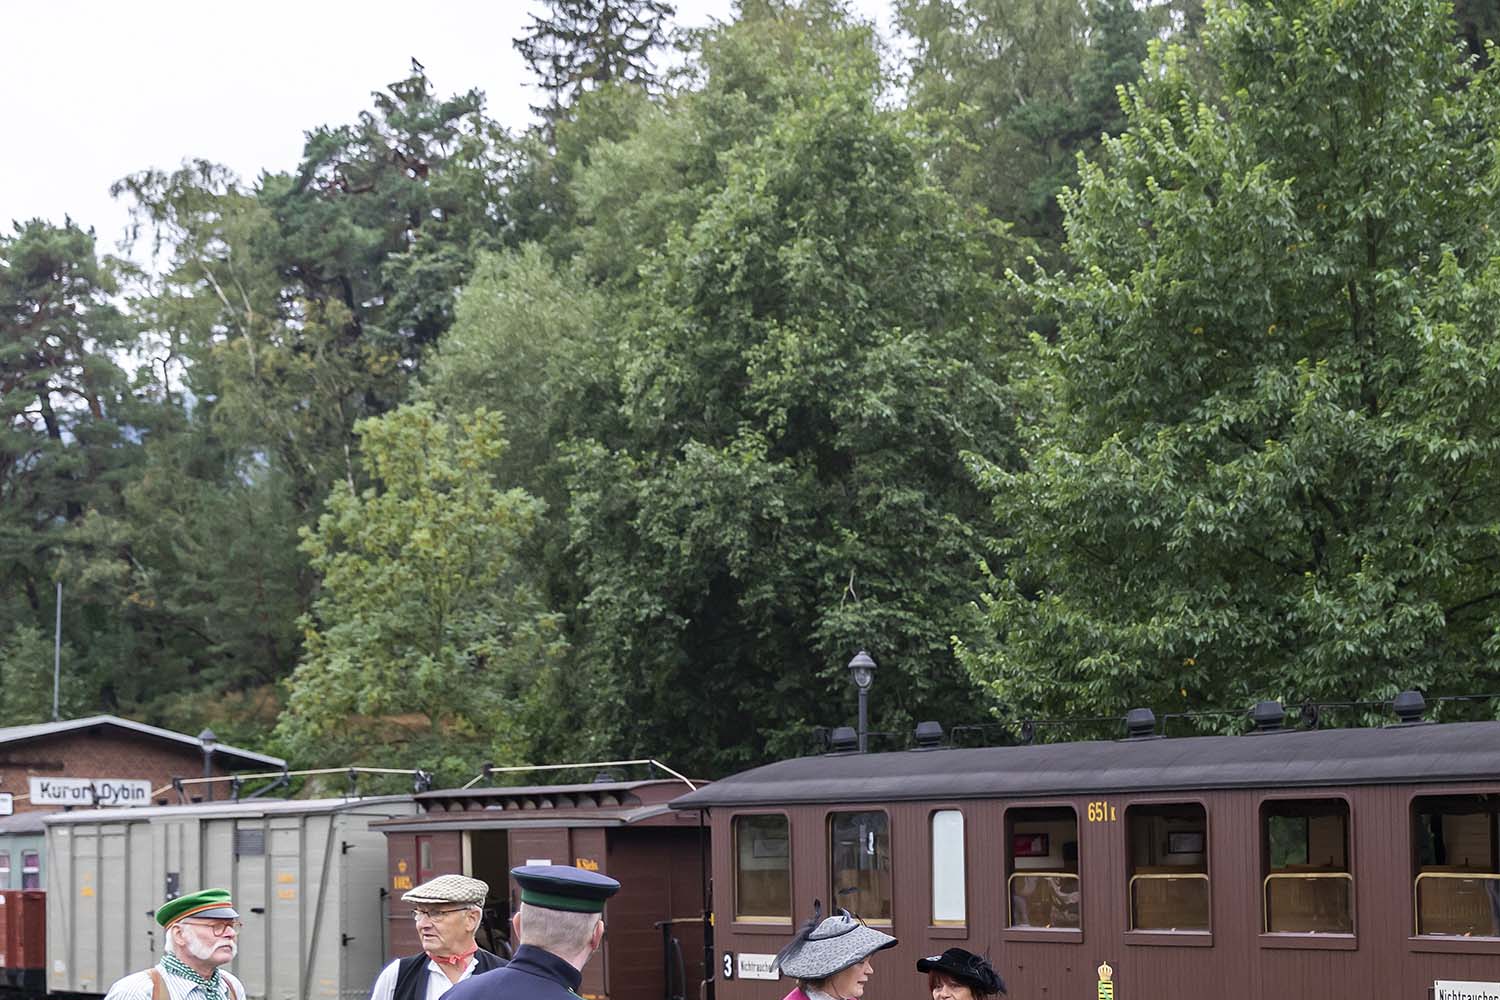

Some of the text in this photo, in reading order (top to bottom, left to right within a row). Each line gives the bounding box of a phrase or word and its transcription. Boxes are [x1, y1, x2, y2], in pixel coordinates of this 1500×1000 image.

[101, 783, 145, 804] Oybin
[1087, 801, 1108, 822] 651
[723, 954, 733, 977] 3
